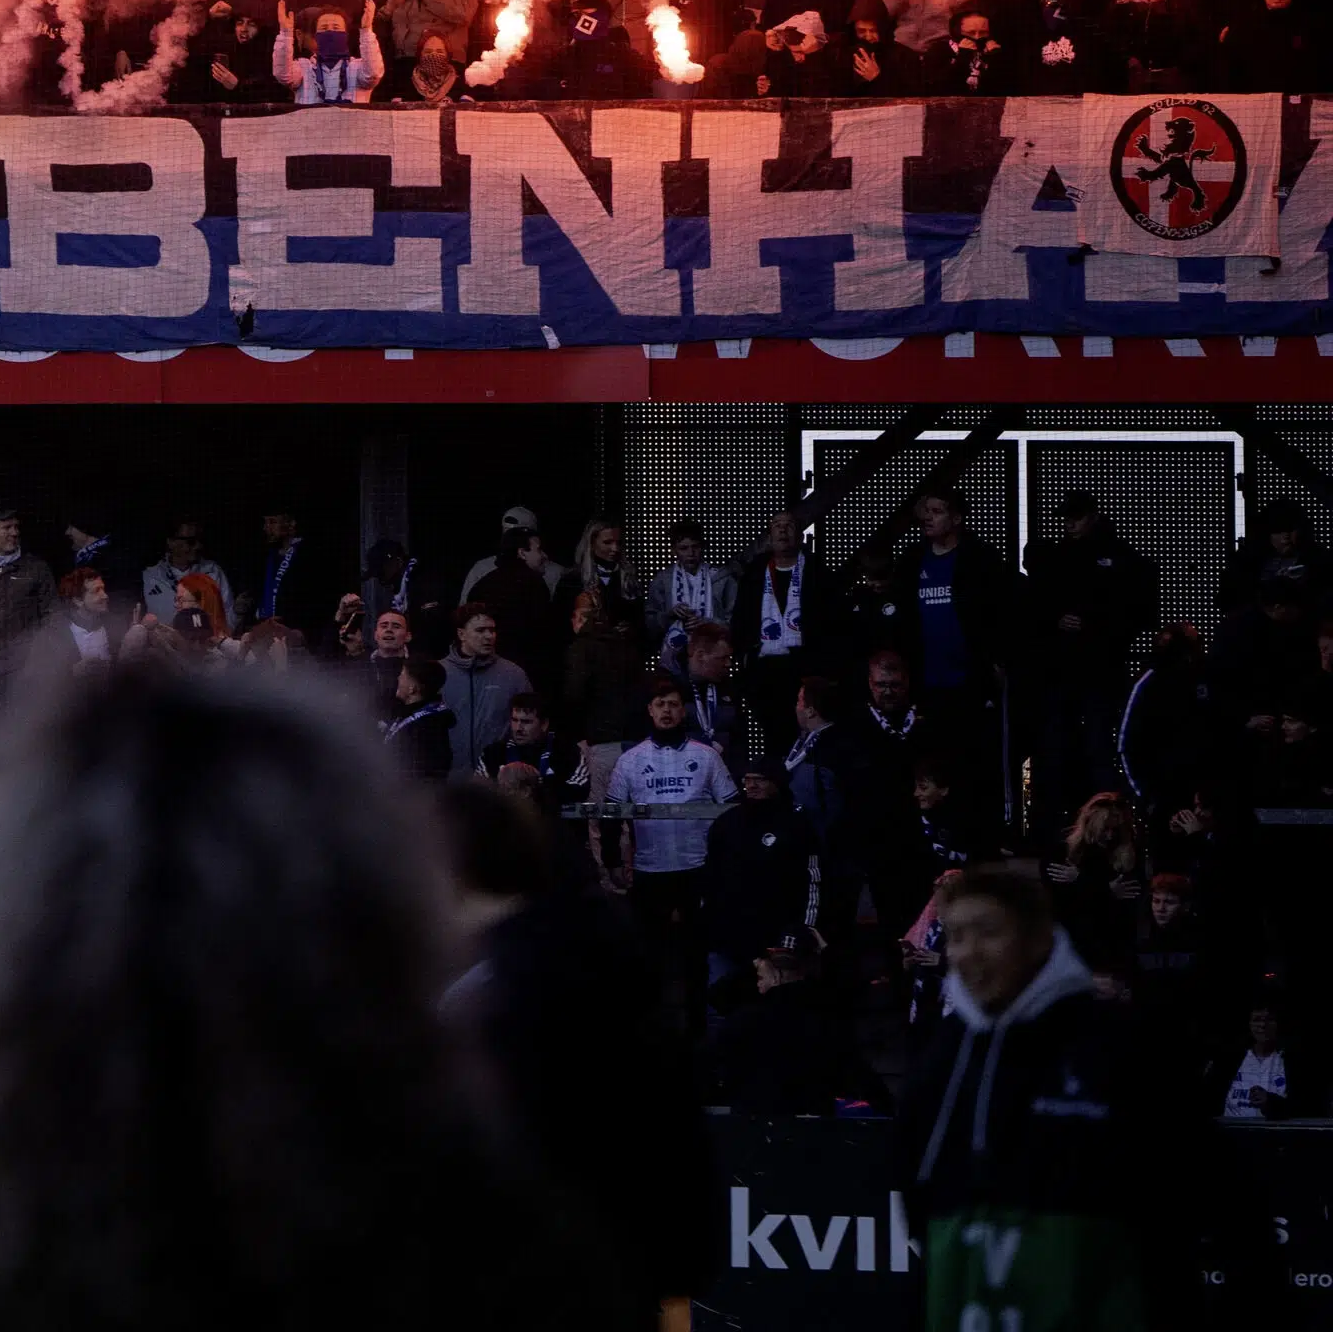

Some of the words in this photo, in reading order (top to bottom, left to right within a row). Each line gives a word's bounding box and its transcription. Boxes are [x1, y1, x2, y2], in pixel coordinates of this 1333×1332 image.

[1148, 98, 1198, 114] SQUAD
[1202, 104, 1216, 116] 92
[1134, 212, 1215, 238] COPENHAGEN
[919, 585, 952, 599] UNIBE
[646, 776, 694, 789] UNIBET
